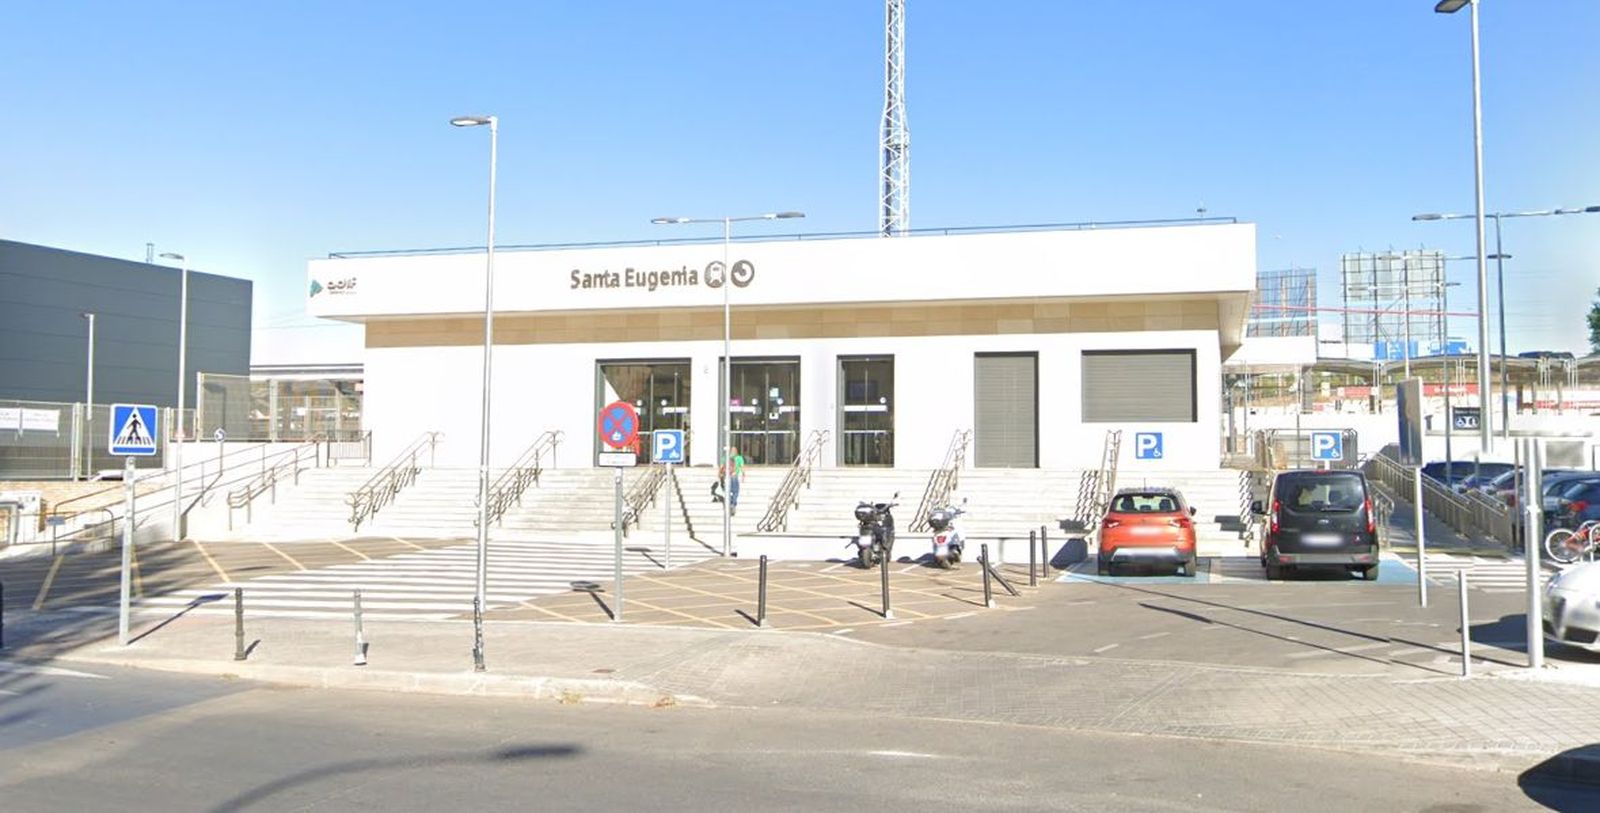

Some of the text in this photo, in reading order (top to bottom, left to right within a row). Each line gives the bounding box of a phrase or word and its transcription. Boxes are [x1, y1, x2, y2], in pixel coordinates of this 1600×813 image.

[570, 265, 698, 291] Santa Eugenia
[656, 433, 676, 459] P
[1138, 434, 1157, 457] P
[1314, 434, 1335, 457] P
